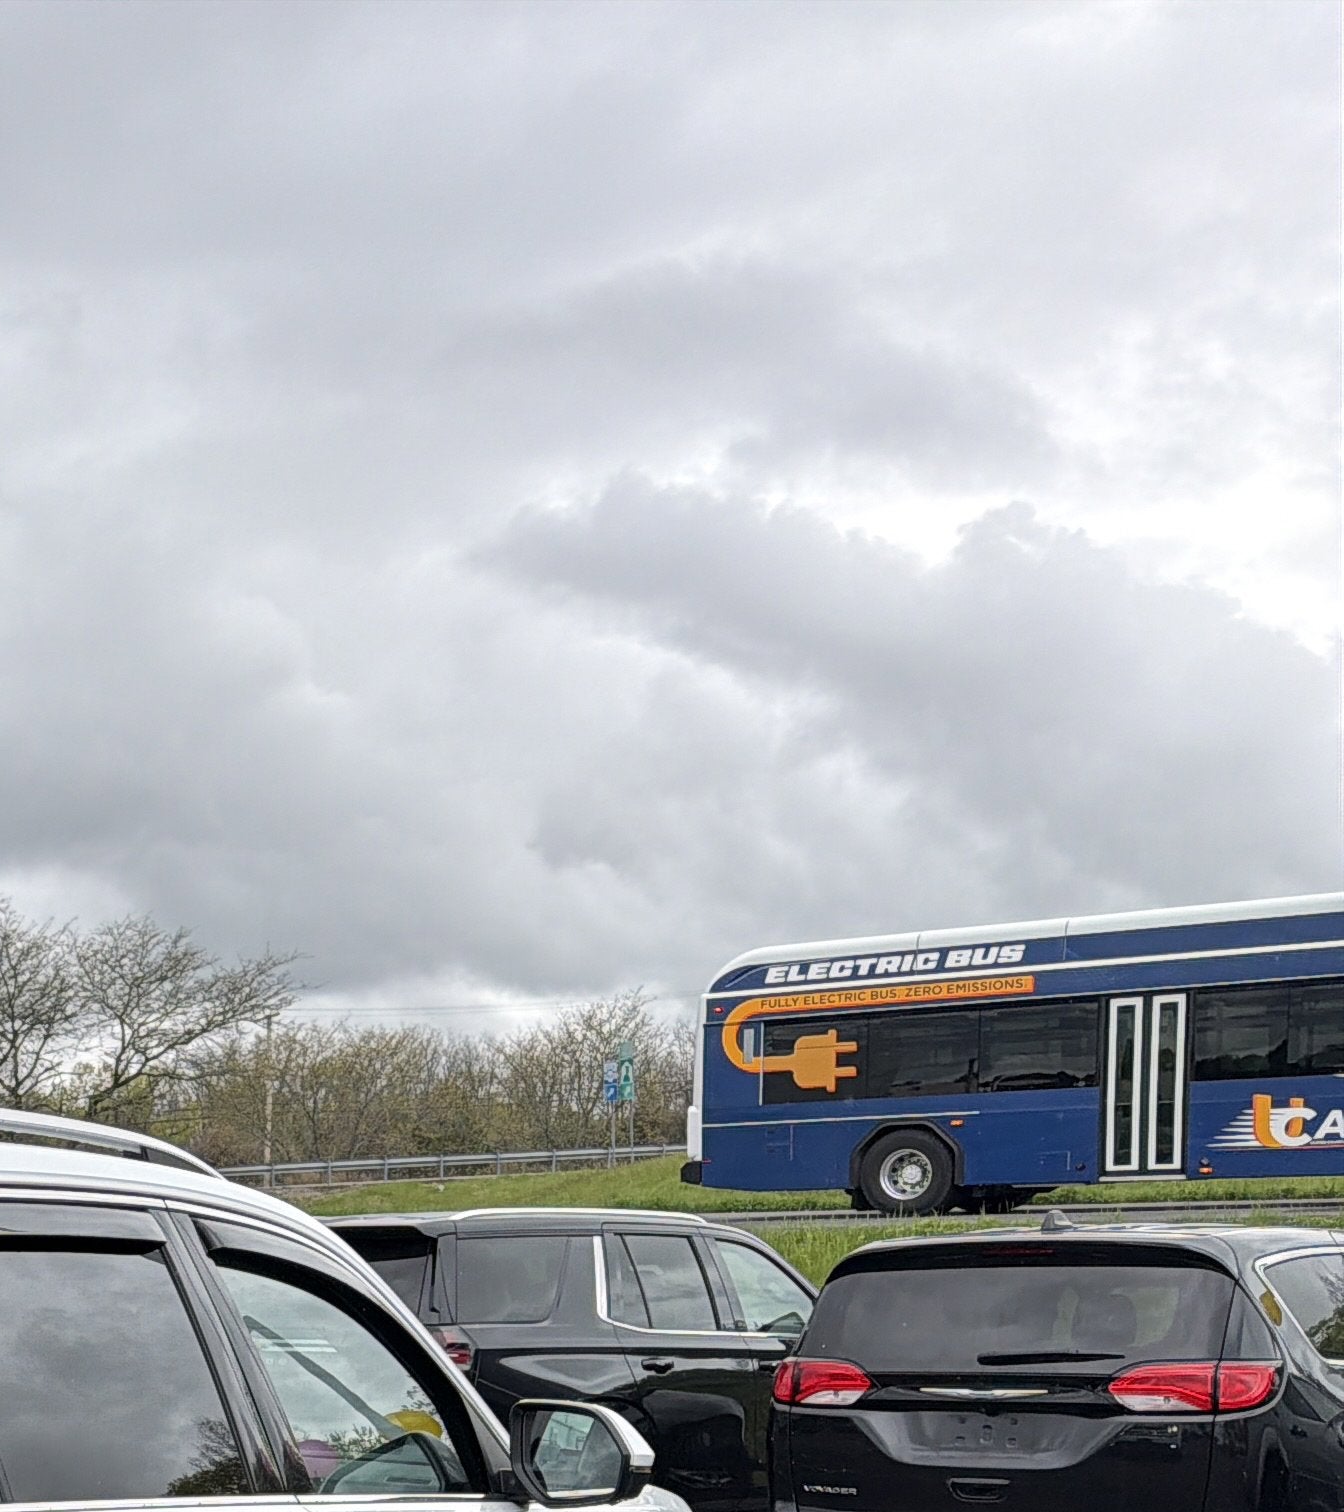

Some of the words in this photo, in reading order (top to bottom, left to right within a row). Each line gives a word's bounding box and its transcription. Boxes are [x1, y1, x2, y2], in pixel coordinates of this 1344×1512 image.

[765, 952, 940, 984] ELECTRIC
[944, 944, 1025, 968] BUS
[761, 996, 800, 1009] FULLY
[803, 991, 868, 1005] ELECTRIC
[905, 985, 942, 997] ZERO
[947, 978, 1028, 994] EMISSIONS.
[803, 1484, 858, 1496] VOYAGER
